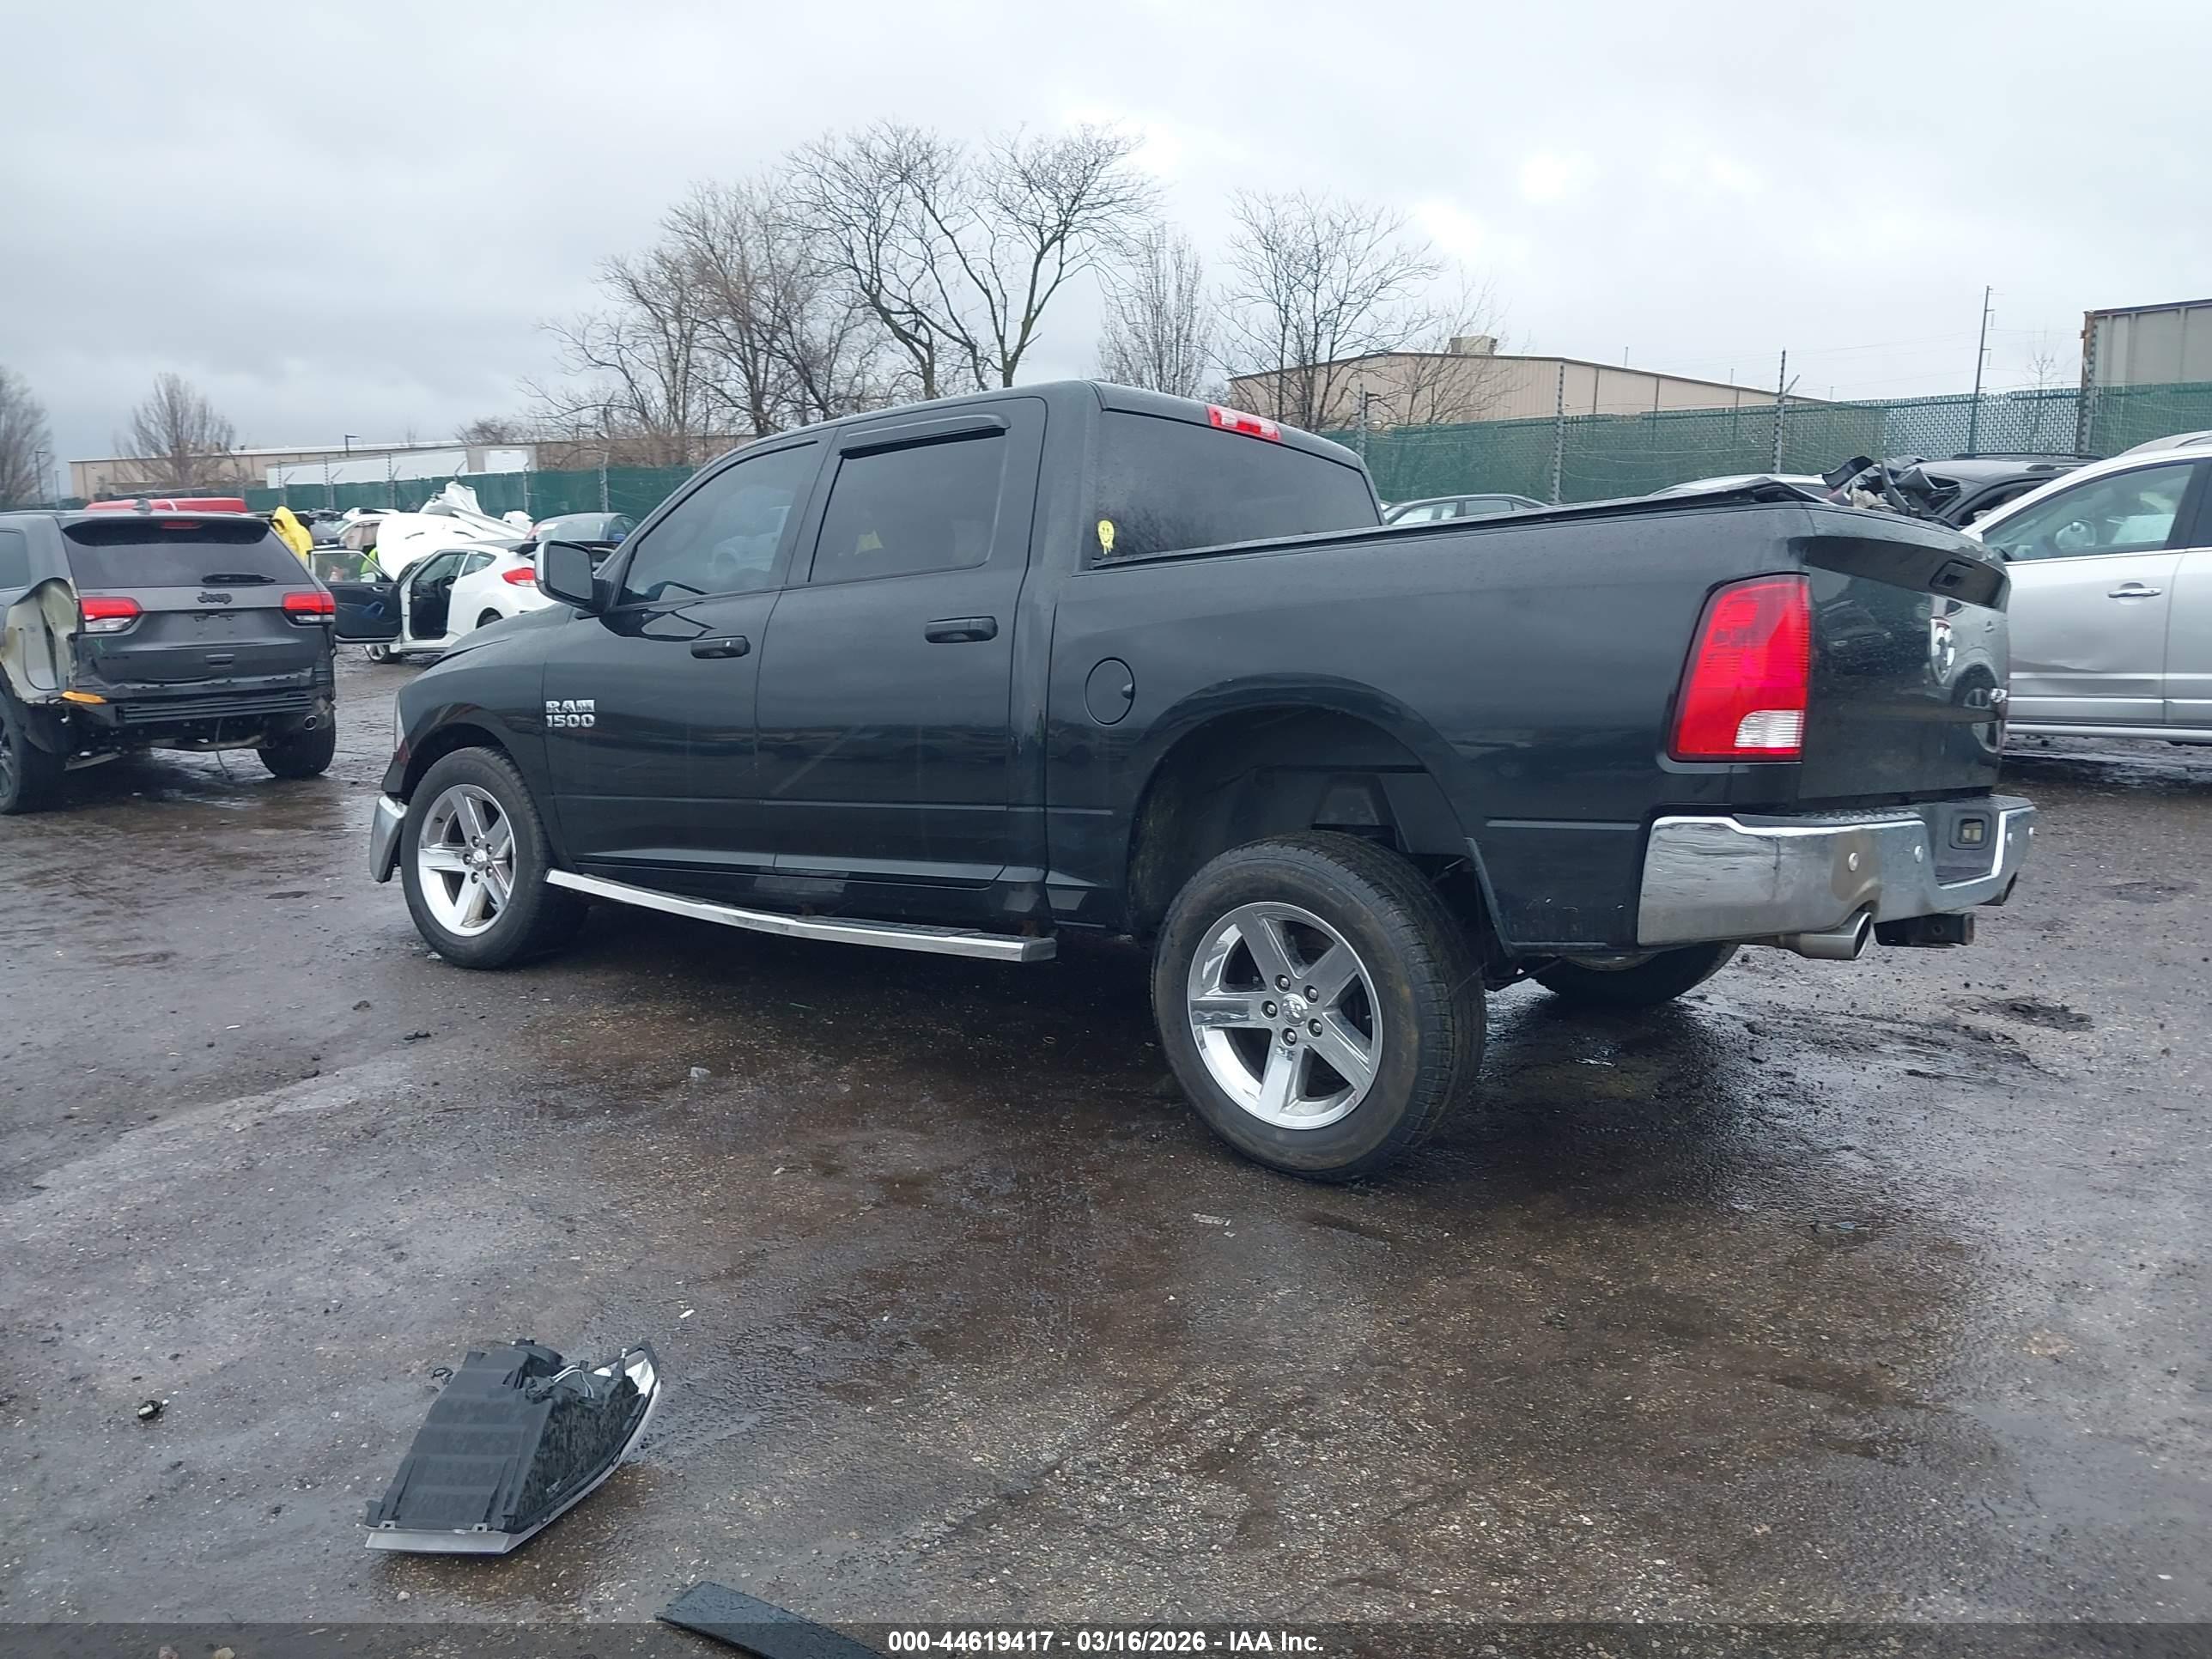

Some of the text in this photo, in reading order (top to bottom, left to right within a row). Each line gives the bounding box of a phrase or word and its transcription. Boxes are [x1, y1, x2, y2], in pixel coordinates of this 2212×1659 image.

[197, 591, 233, 605] Jeep
[545, 699, 595, 714] RAM
[545, 714, 595, 728] 1500
